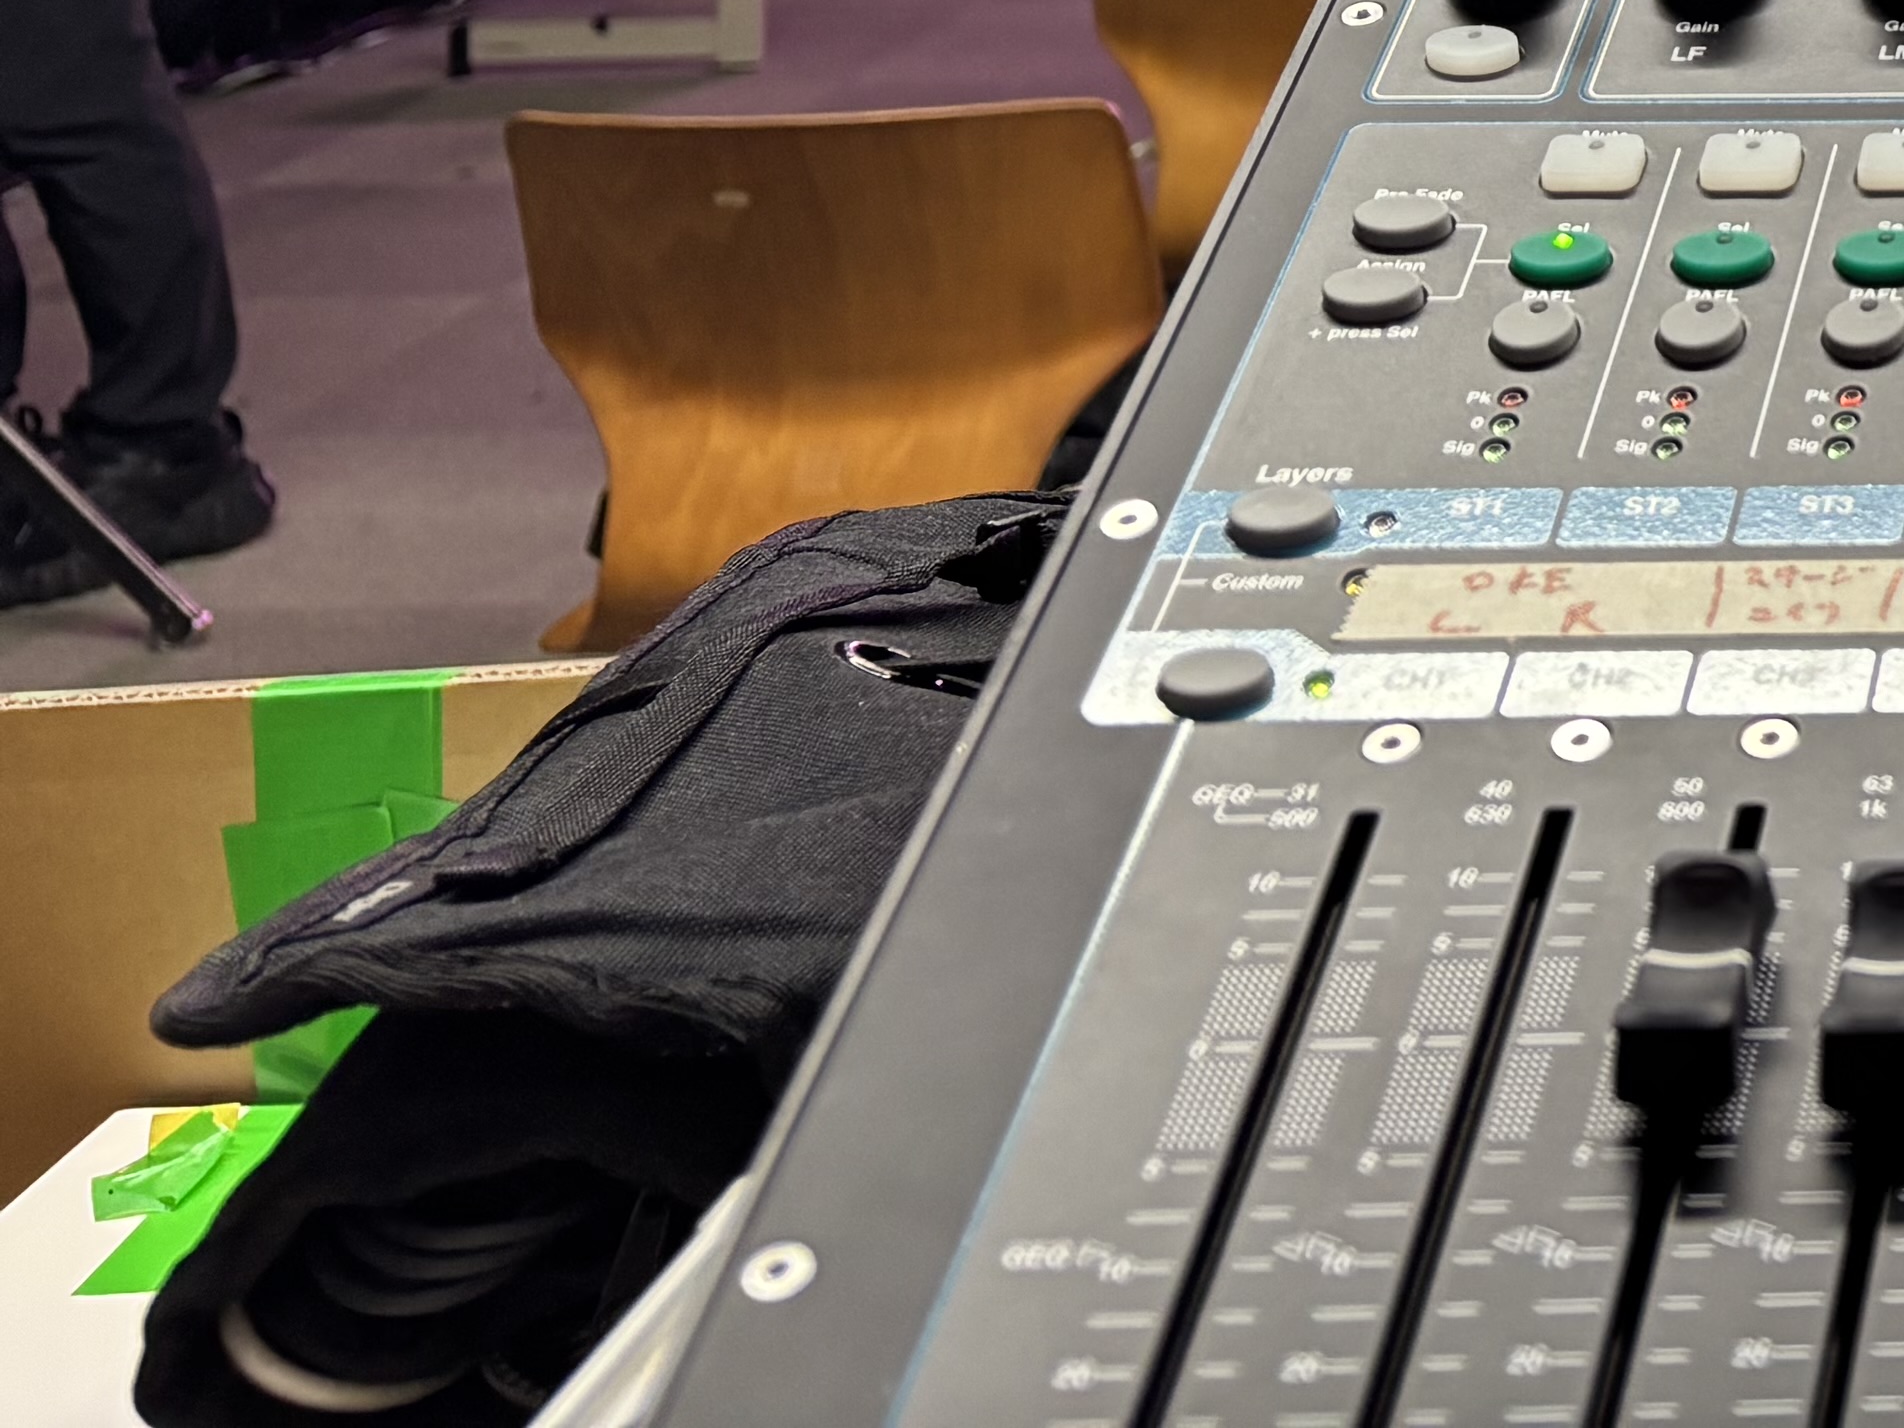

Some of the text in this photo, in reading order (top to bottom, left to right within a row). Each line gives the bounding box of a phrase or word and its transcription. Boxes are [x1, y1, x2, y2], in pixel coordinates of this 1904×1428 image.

[1675, 21, 1719, 34] Gain
[1670, 46, 1707, 62] LF
[1326, 325, 1419, 342] press Sel
[1255, 464, 1353, 488] Layers
[1623, 496, 1682, 516] ST2
[1800, 494, 1856, 515] ST3
[1211, 572, 1304, 592] Custom
[1862, 774, 1894, 794] 63
[1861, 799, 1887, 818] 1k
